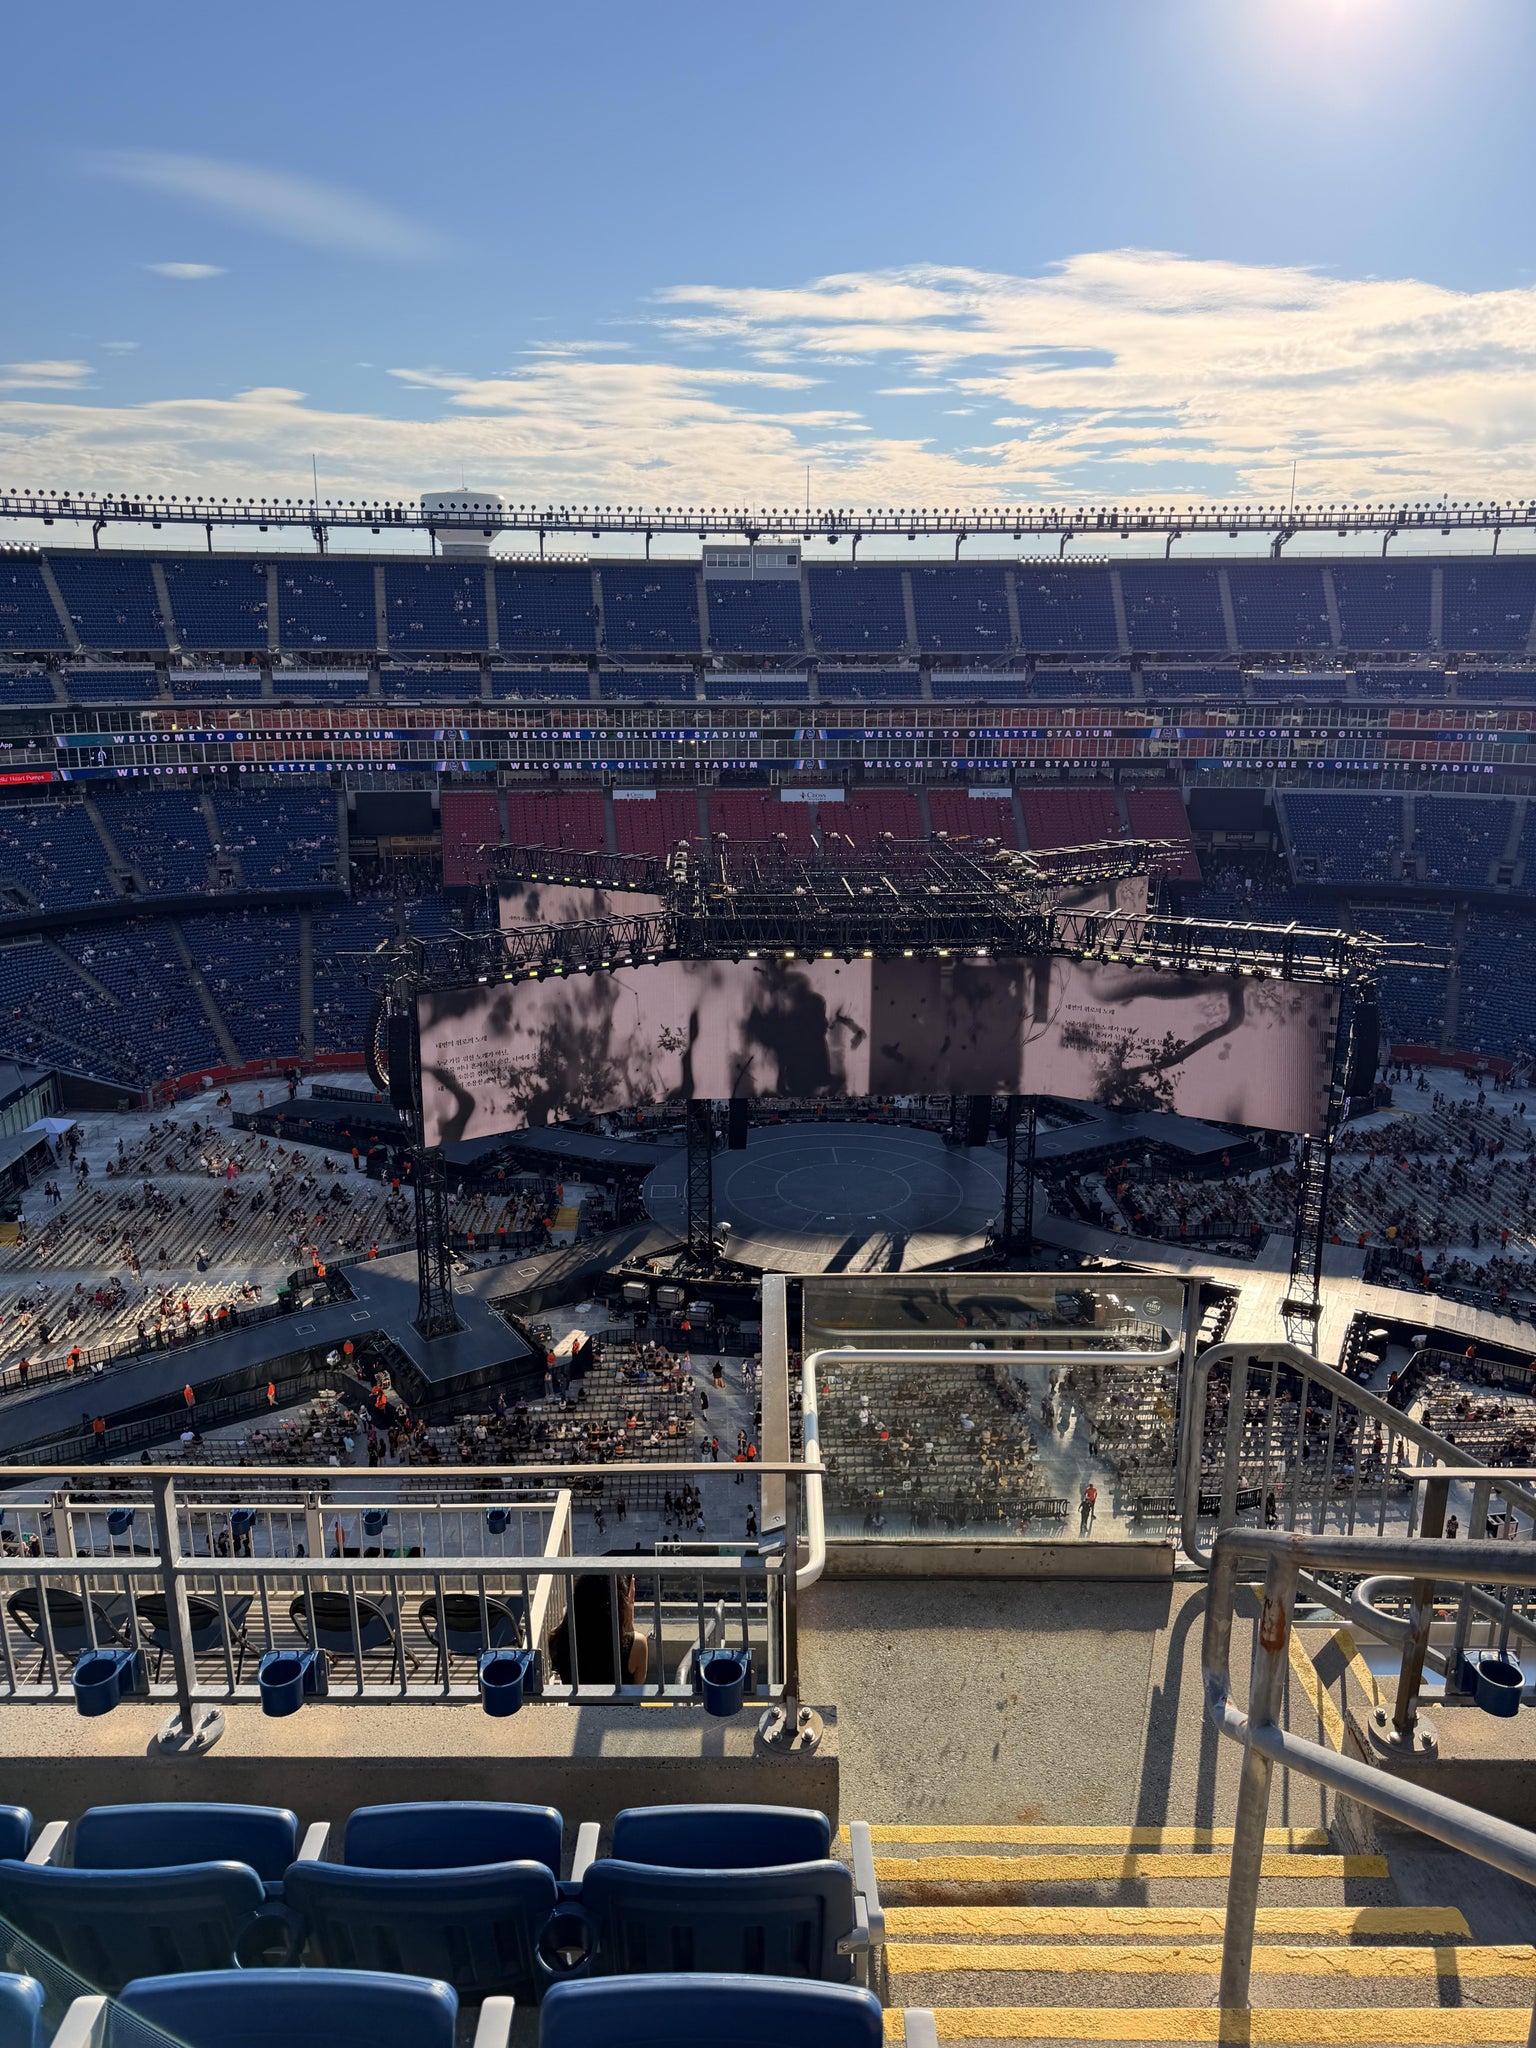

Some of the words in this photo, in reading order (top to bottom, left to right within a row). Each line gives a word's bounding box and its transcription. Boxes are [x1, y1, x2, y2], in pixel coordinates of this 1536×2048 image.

[113, 734, 195, 744] WELCOME
[206, 733, 225, 741] TO
[236, 731, 314, 740] GILLETTE
[323, 731, 394, 739] STADIUM
[508, 731, 581, 739] WELCOME
[590, 731, 607, 739] TO
[616, 731, 686, 739] GILLETTE
[694, 731, 758, 739] STADIUM
[864, 730, 934, 738] WELCOME
[943, 730, 960, 738] TO
[968, 730, 1038, 738] GILLETTE
[1225, 730, 1300, 738] WELCOME
[1311, 730, 1328, 738] TO
[510, 762, 582, 770] WELCOME
[864, 760, 933, 768] WELCOME
[942, 760, 958, 768] TO
[967, 760, 1036, 768] GILLETTE
[1045, 760, 1111, 768] STADIUM
[1223, 760, 1297, 768] WELCOME
[1307, 761, 1325, 769] TO
[1335, 762, 1410, 770] GILLETTE
[1420, 763, 1494, 773] STADIUM
[117, 766, 199, 776] WELCOME
[209, 765, 228, 773] TO
[239, 763, 316, 772] GILLETTE
[326, 763, 396, 771] STADIUM
